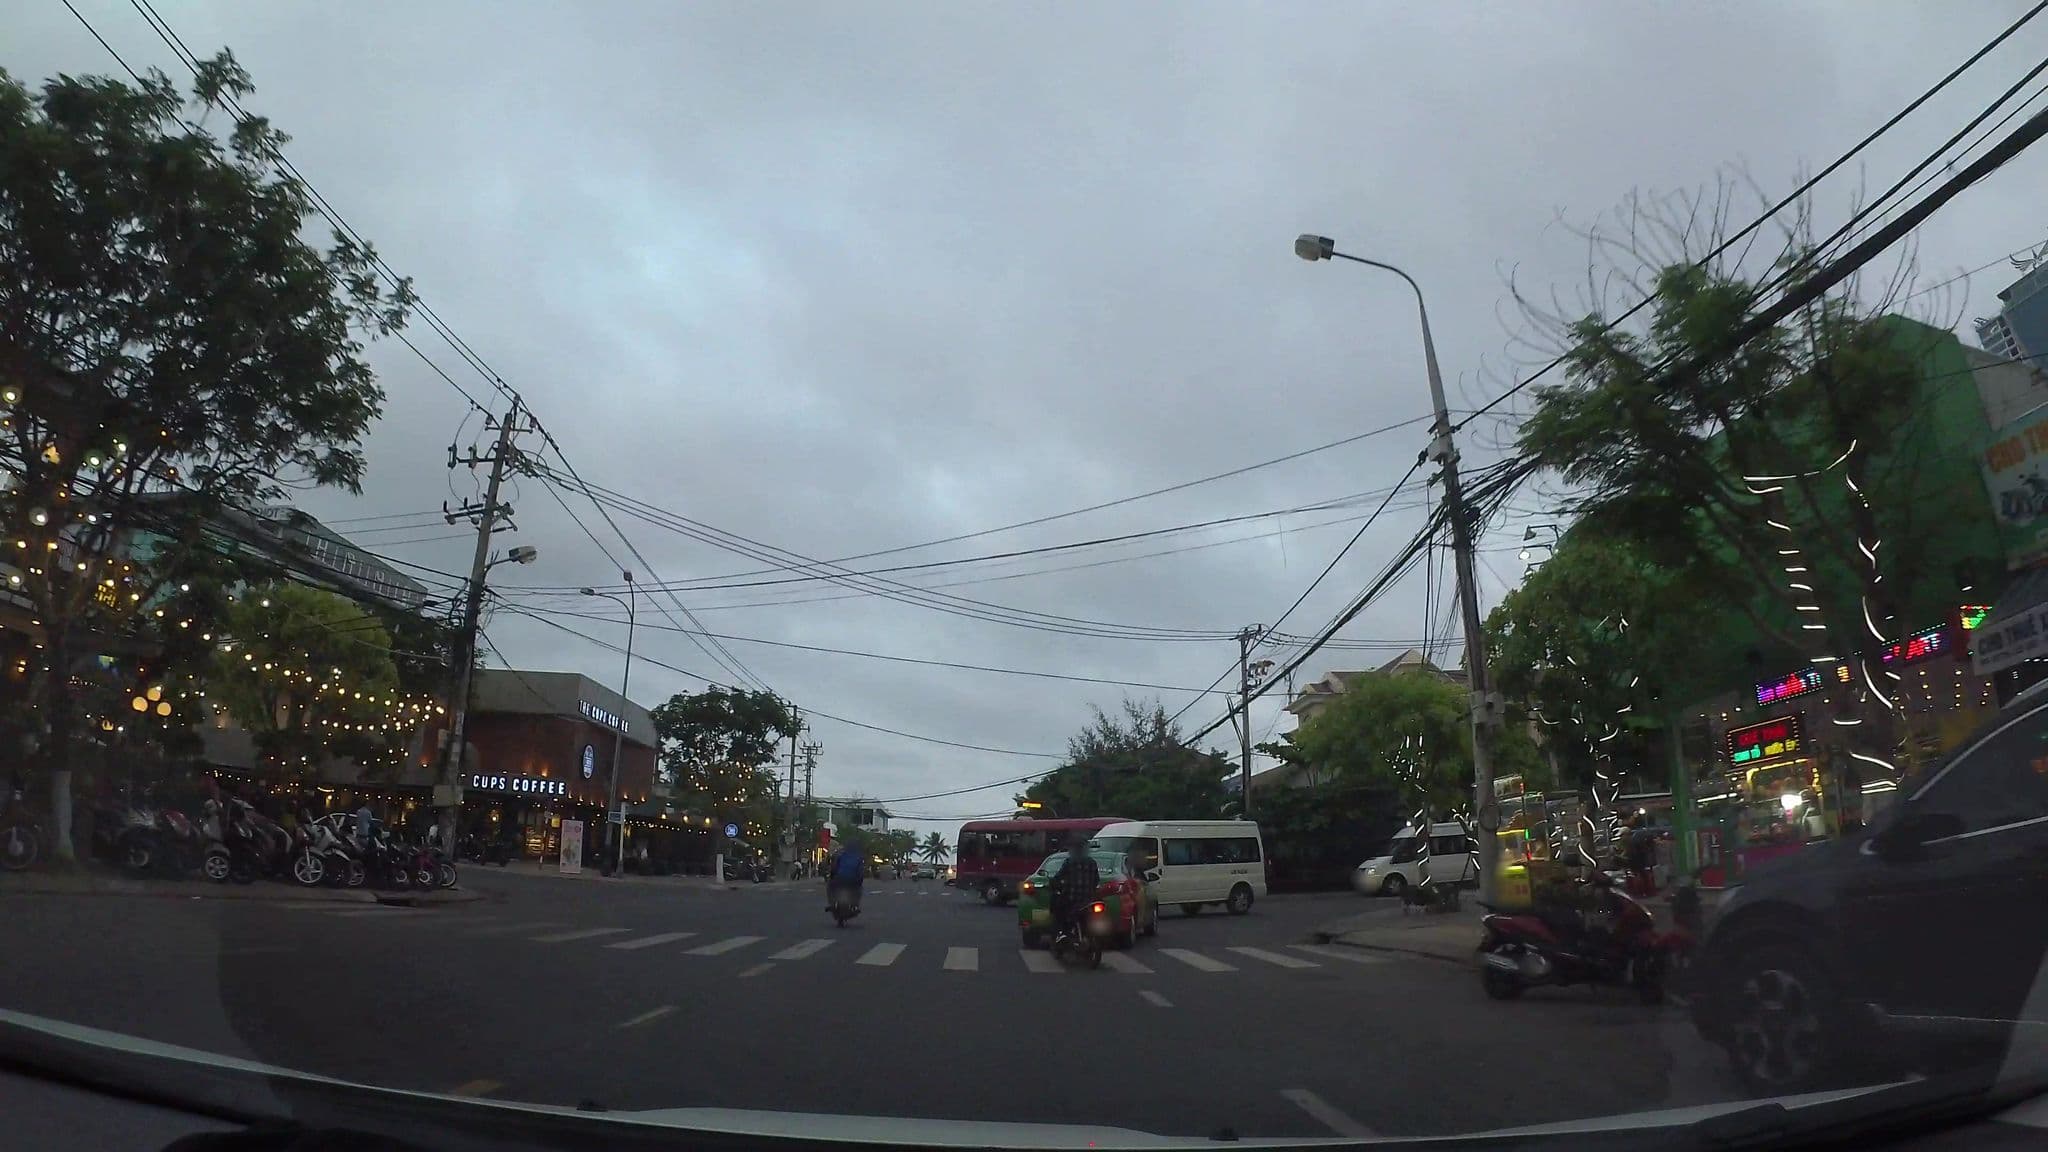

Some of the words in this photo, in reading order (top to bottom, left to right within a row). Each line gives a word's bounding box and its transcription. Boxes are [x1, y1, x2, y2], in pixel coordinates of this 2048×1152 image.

[579, 700, 590, 716] THE
[592, 706, 606, 722] CUPS
[608, 713, 629, 732] COFEE
[473, 774, 506, 790] CUPS
[512, 778, 567, 795] COFFEE
